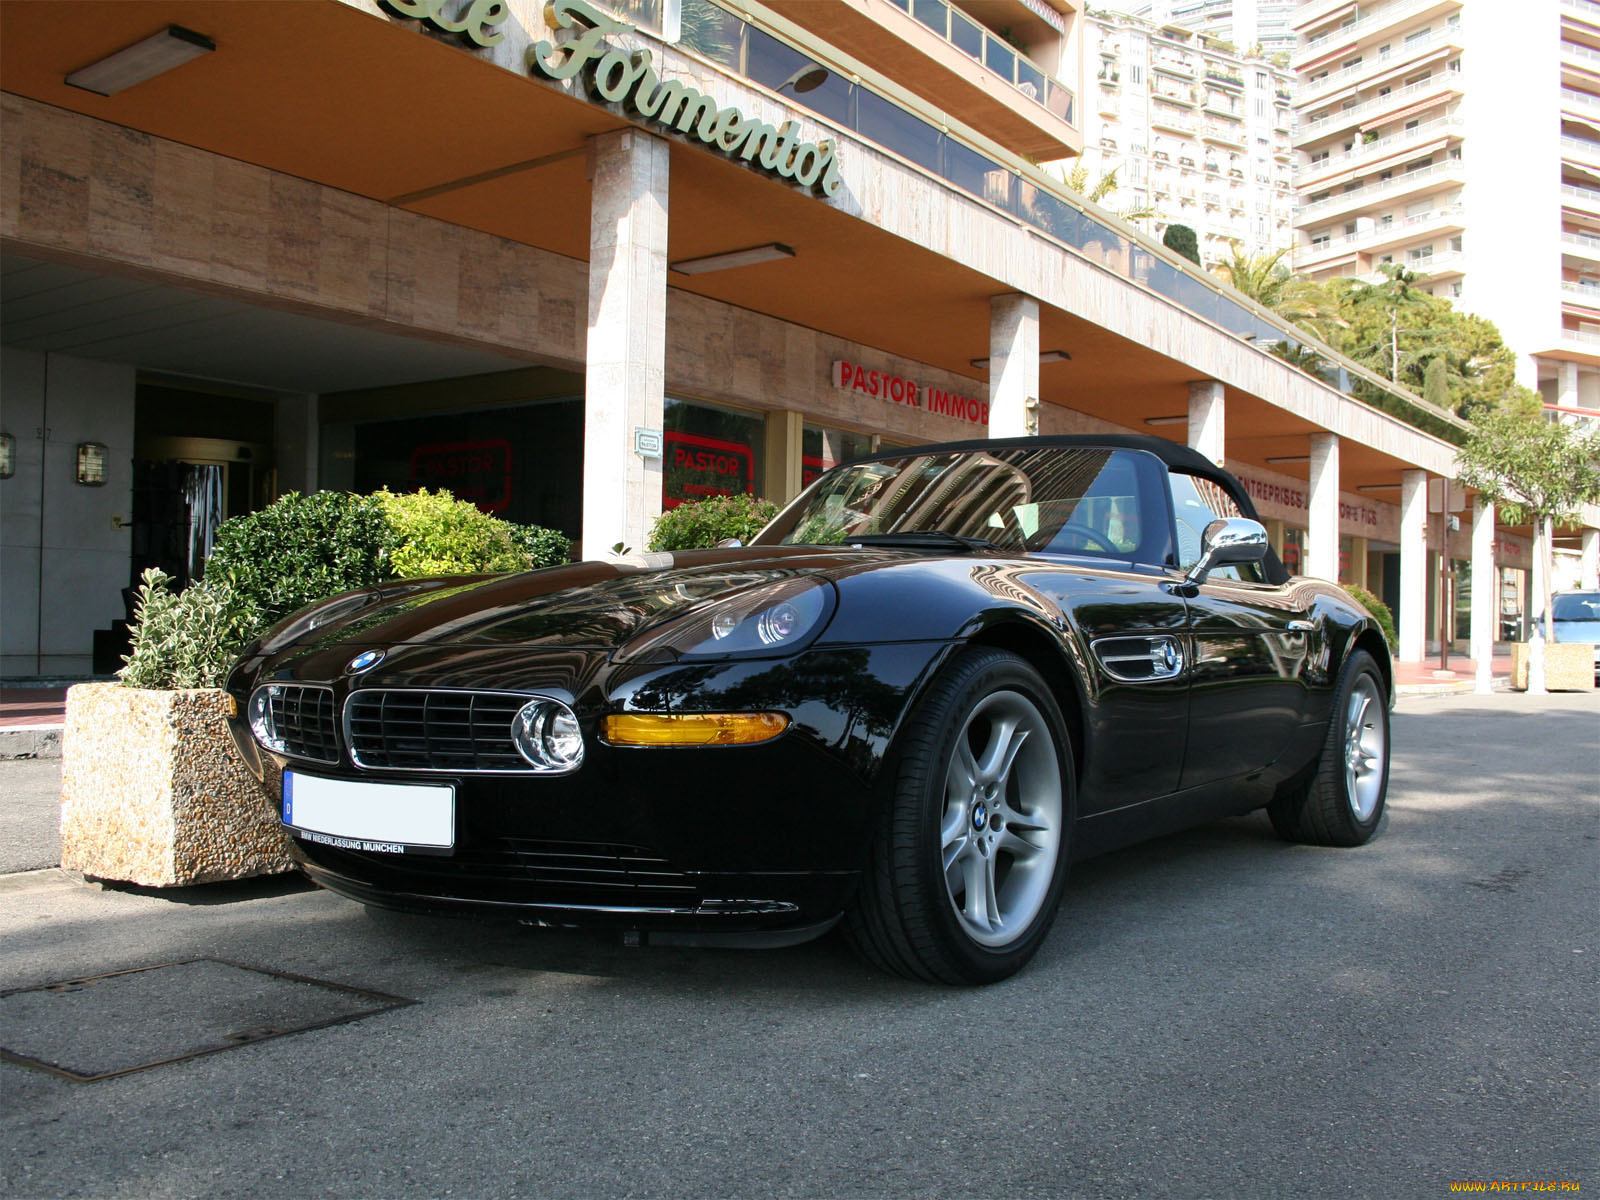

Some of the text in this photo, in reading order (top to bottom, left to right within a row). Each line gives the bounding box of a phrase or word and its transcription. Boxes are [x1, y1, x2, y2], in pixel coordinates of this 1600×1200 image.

[530, 0, 841, 197] Formentor
[841, 360, 917, 407] PASTOR
[675, 448, 739, 476] PASTOR
[286, 802, 291, 815] D
[301, 831, 312, 841] BMW
[312, 833, 361, 850] NIEDERLASSUNG
